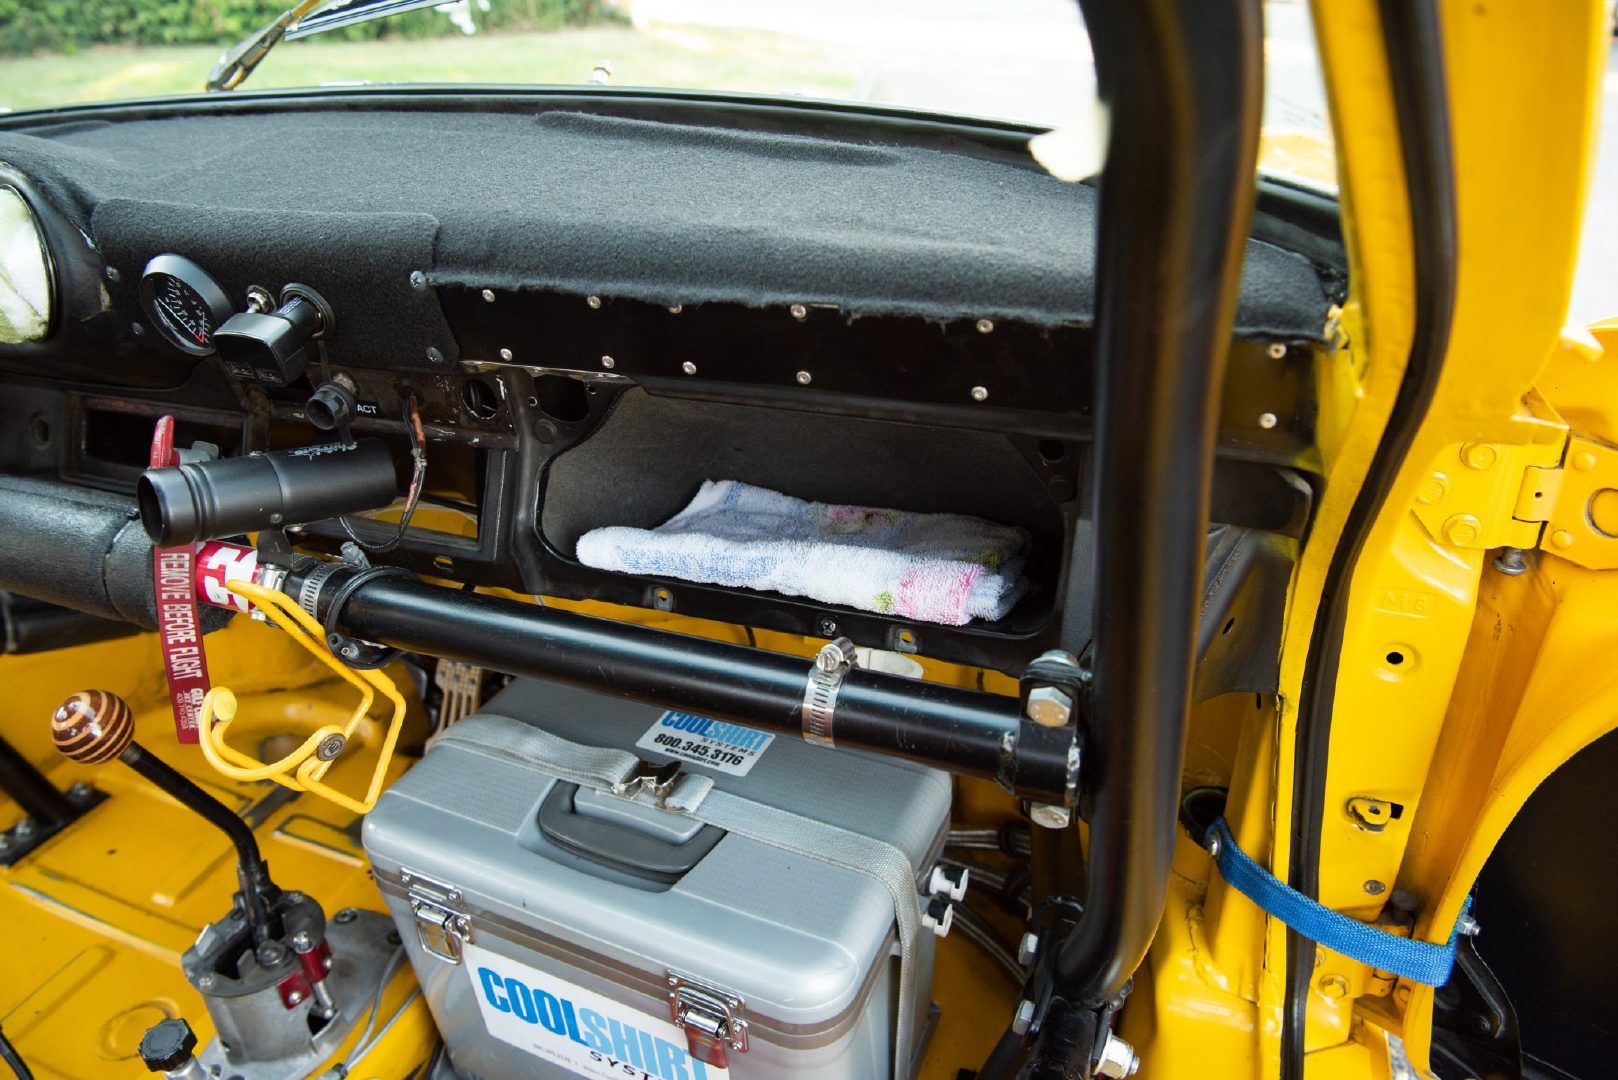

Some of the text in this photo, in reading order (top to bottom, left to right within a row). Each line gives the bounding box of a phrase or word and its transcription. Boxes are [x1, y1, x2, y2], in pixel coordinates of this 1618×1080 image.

[356, 403, 377, 414] ACT
[160, 552, 203, 680] REMOVE BEFORE FLIGHT
[661, 711, 771, 750] COOLSHIRT
[654, 733, 744, 765] 800.345.3176
[665, 748, 720, 766] www.coolshirt.com
[700, 738, 756, 756] SYSTEMS
[589, 1050, 662, 1080] SYST
